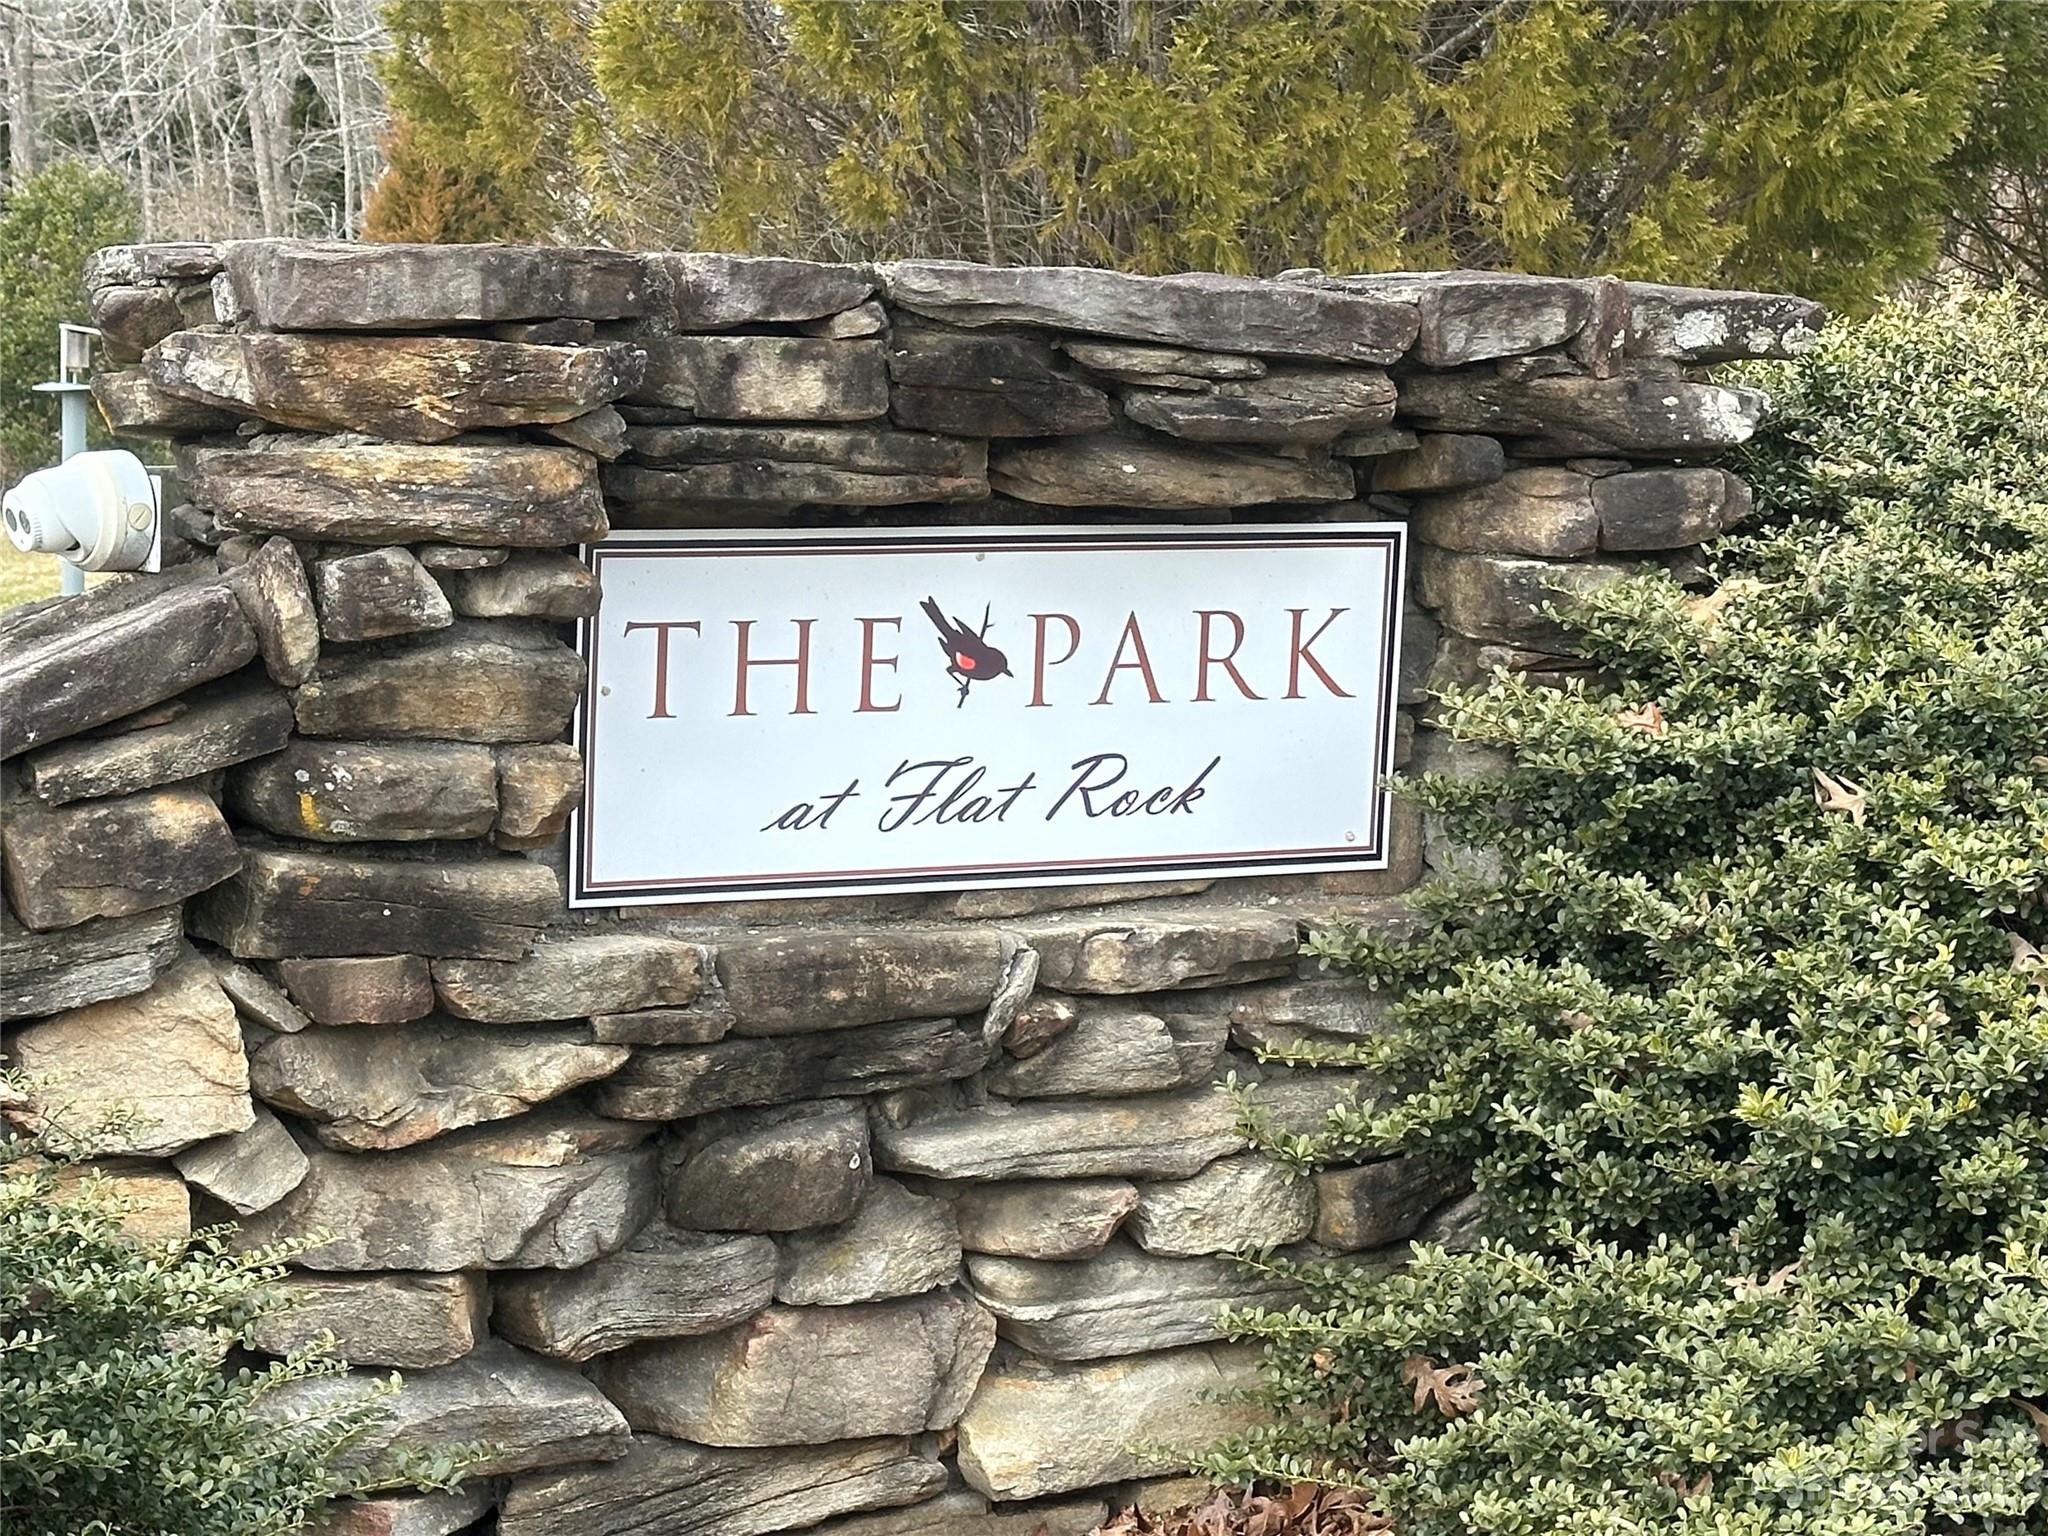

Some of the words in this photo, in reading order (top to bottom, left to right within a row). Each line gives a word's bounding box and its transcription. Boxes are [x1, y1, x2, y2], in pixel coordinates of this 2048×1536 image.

[623, 616, 903, 720] THE
[1024, 607, 1357, 707] PARK
[760, 778, 861, 832] at
[878, 755, 1037, 833] Flat
[1045, 752, 1221, 822] Rock
